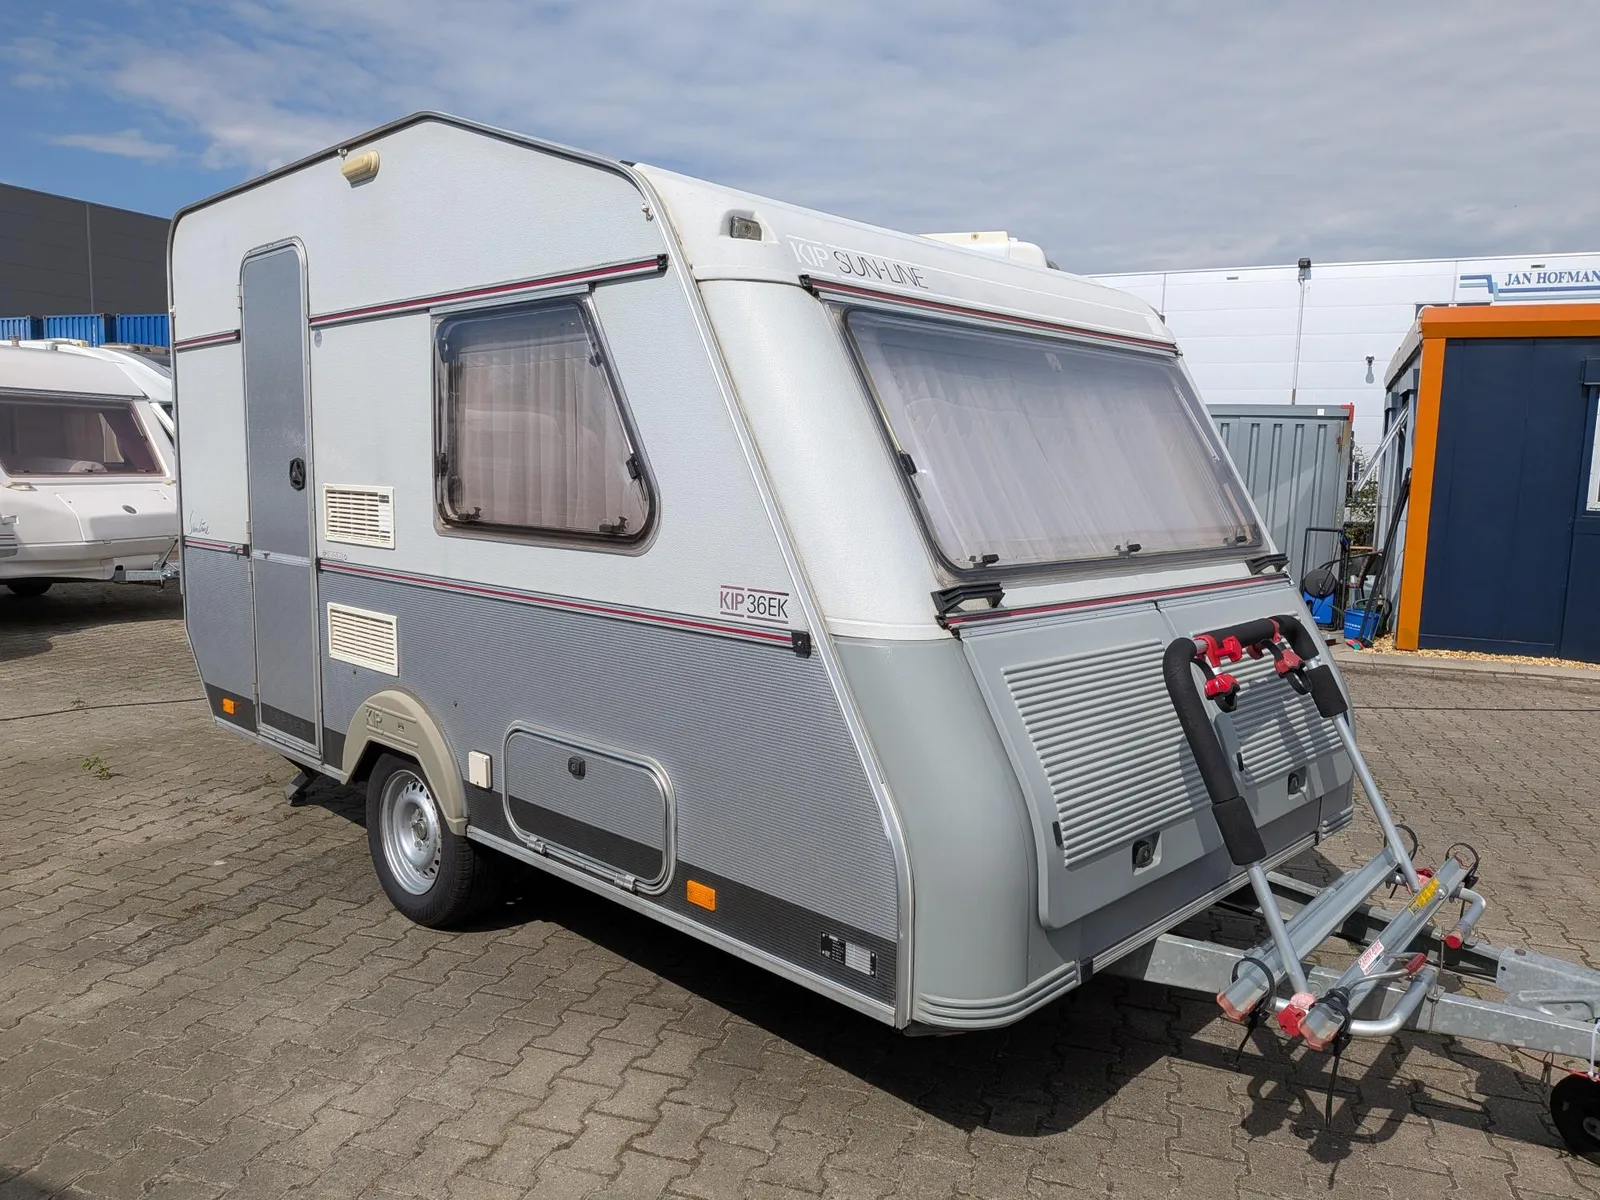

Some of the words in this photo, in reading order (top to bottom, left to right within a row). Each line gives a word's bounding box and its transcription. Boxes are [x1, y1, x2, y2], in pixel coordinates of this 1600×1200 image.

[788, 241, 829, 268] KIP
[833, 251, 929, 289] SUN-LINE
[1505, 272, 1533, 287] JAN
[1536, 270, 1600, 285] HOFMAN
[720, 591, 745, 611] KIP
[746, 594, 789, 619] 36EK
